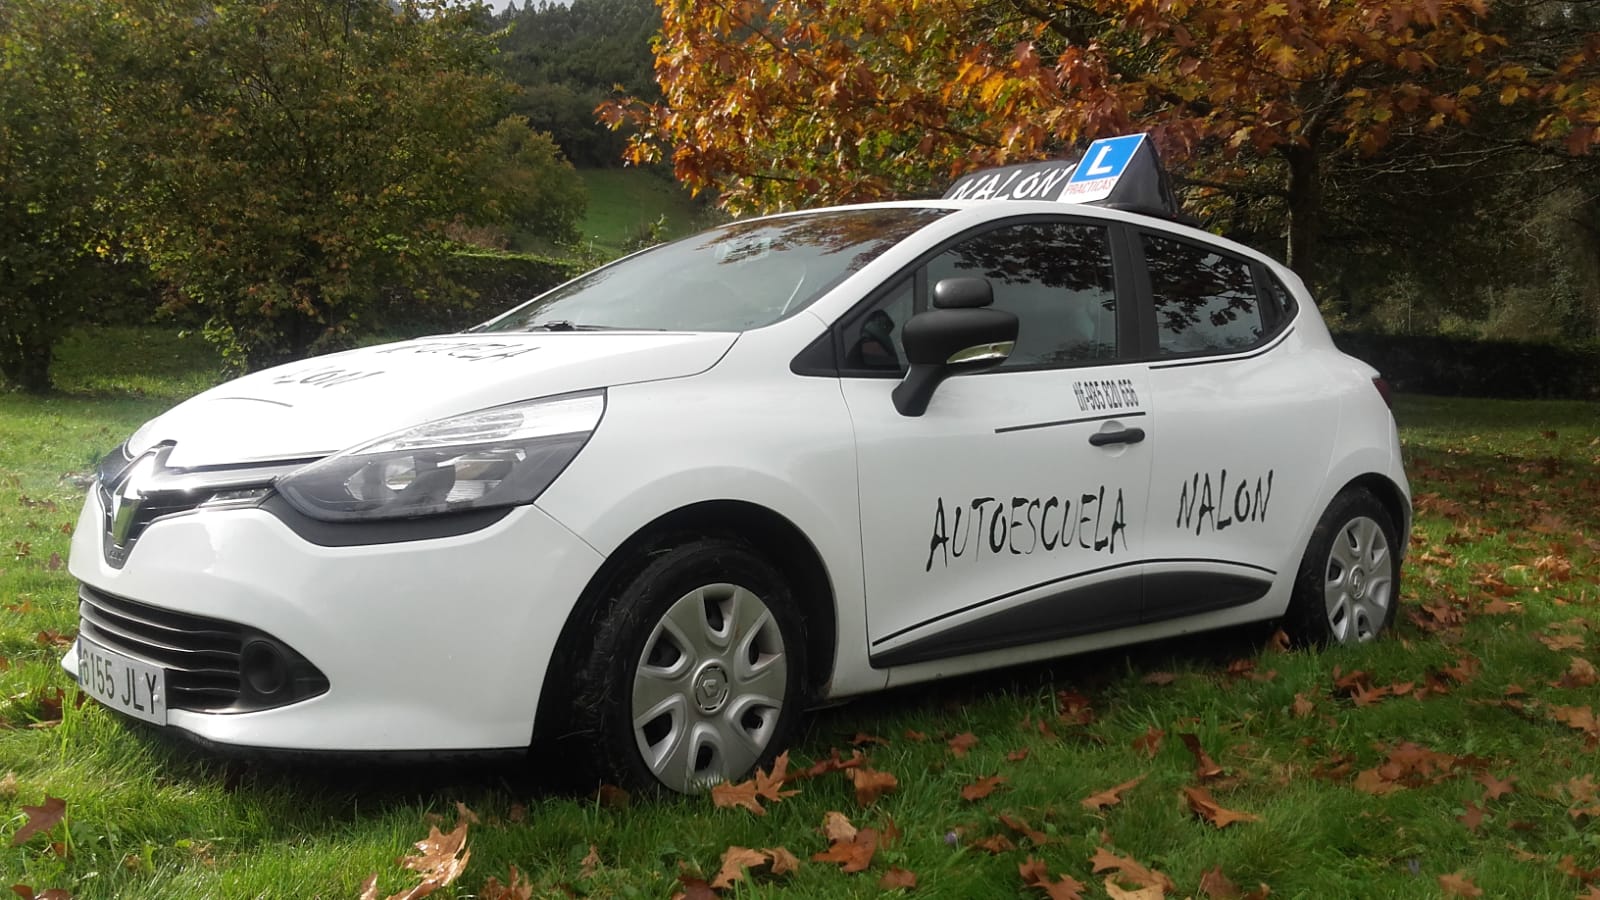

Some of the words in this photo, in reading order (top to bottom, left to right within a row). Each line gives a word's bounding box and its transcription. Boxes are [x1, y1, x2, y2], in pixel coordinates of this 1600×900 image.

[1086, 145, 1113, 176] L
[1101, 380, 1123, 409] 820
[926, 485, 1127, 572] AUTOESCUELA
[1176, 469, 1274, 536] NALON
[82, 648, 115, 699] 6155
[121, 667, 157, 714] JLY
